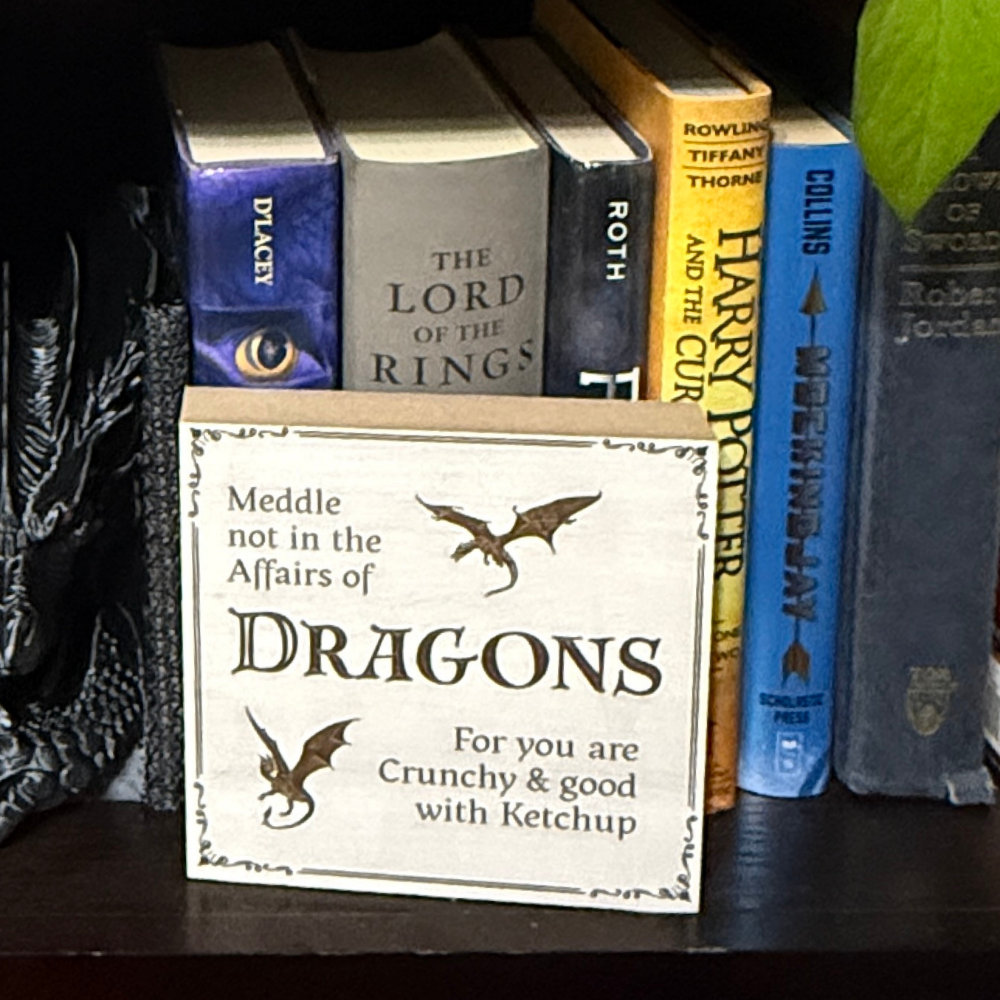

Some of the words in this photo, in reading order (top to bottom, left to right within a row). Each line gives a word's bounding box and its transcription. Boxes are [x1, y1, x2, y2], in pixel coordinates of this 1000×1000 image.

[688, 147, 765, 163] TIFFANY
[686, 171, 763, 188] THORNE
[803, 169, 835, 255] COLLINS
[253, 196, 274, 286] D'LACEY
[431, 248, 492, 271] THE
[606, 200, 629, 280] ROTH
[686, 233, 705, 281] AND
[388, 273, 525, 315] LORD
[682, 285, 703, 325] THE
[708, 224, 763, 387] HARRY
[413, 325, 447, 344] OF
[457, 320, 503, 342] THE
[371, 338, 533, 387] RINGS
[228, 485, 341, 515] Meddle
[228, 527, 278, 549] not
[290, 525, 320, 551] in
[332, 526, 382, 553] the
[227, 558, 333, 591] Affairs
[342, 563, 376, 596] of
[228, 607, 663, 697] DRAGONS
[454, 727, 508, 754] For
[516, 736, 575, 762] you
[588, 741, 639, 762] are
[378, 758, 517, 797] Crunchy
[526, 767, 550, 793] &
[559, 773, 637, 802] good
[416, 797, 488, 825] with
[502, 801, 637, 841] Ketchup
